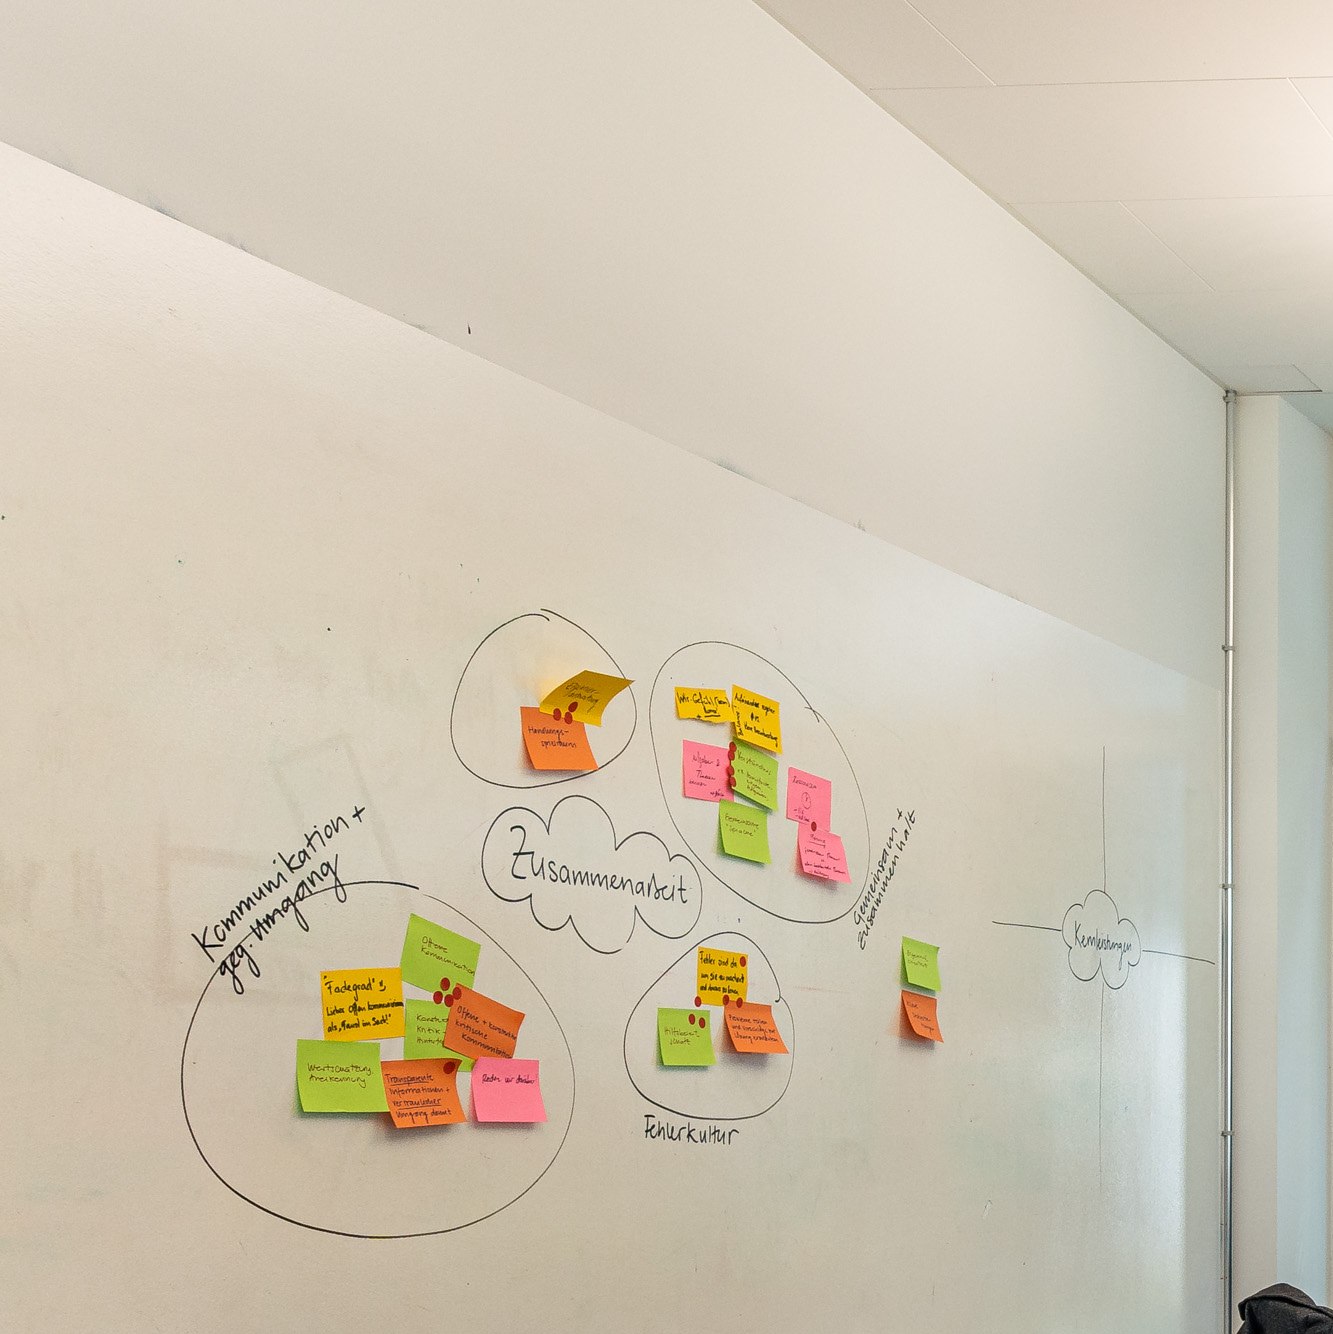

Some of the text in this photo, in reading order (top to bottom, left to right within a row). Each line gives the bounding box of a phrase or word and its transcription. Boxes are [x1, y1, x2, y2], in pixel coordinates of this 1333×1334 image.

[191, 816, 350, 963] Kommunikation
[510, 825, 688, 904] Zusammenarbeit
[1074, 920, 1132, 971] Kernleistungen
[644, 1114, 740, 1145] Fehlerkultur
